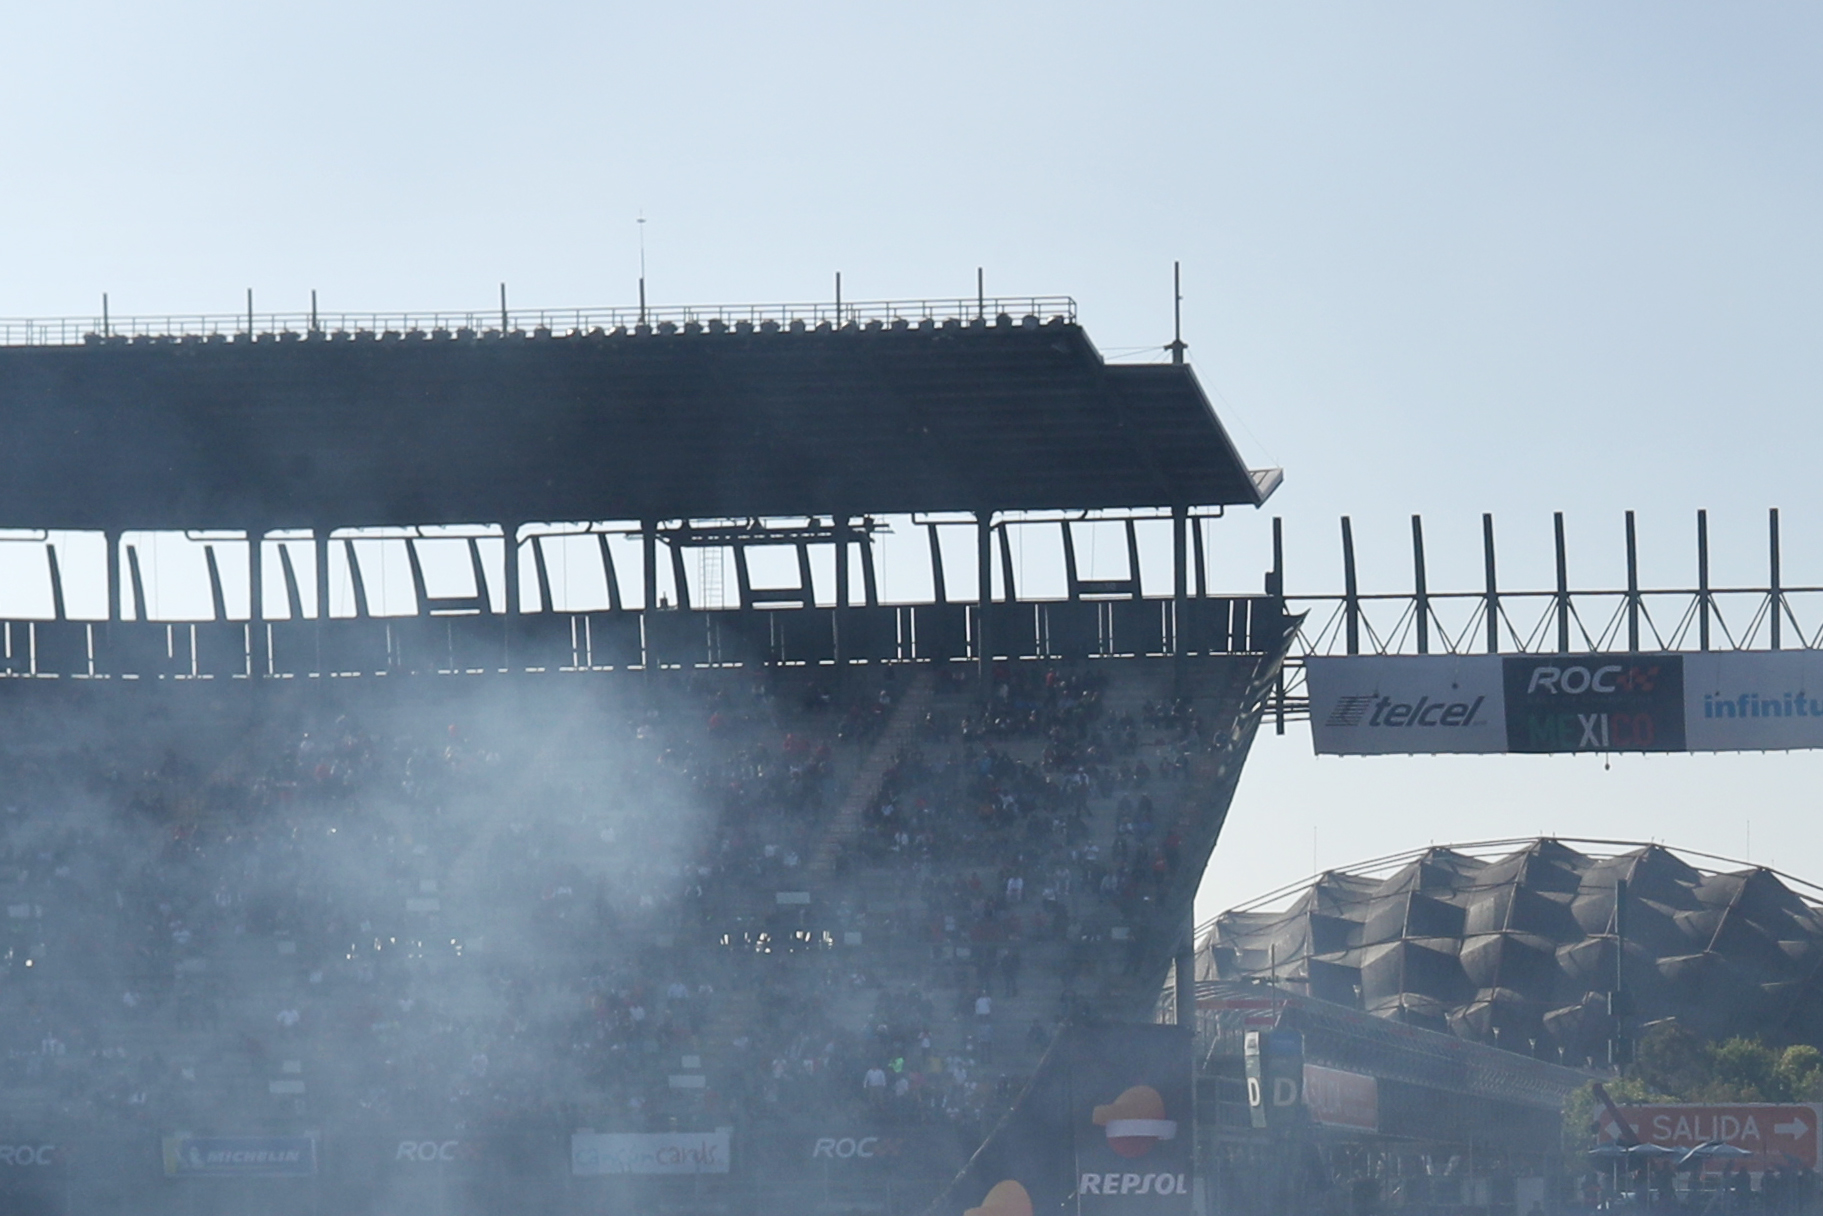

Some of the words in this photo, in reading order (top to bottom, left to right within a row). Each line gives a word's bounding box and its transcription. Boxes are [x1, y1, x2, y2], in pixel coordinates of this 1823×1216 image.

[1527, 665, 1623, 694] ROC
[1369, 695, 1486, 727] telcel
[1529, 711, 1653, 748] MEXICO
[1651, 1115, 1760, 1141] SALIDA
[396, 1140, 460, 1161] ROC
[813, 1136, 878, 1159] ROC
[1080, 1173, 1187, 1196] REPSOL
